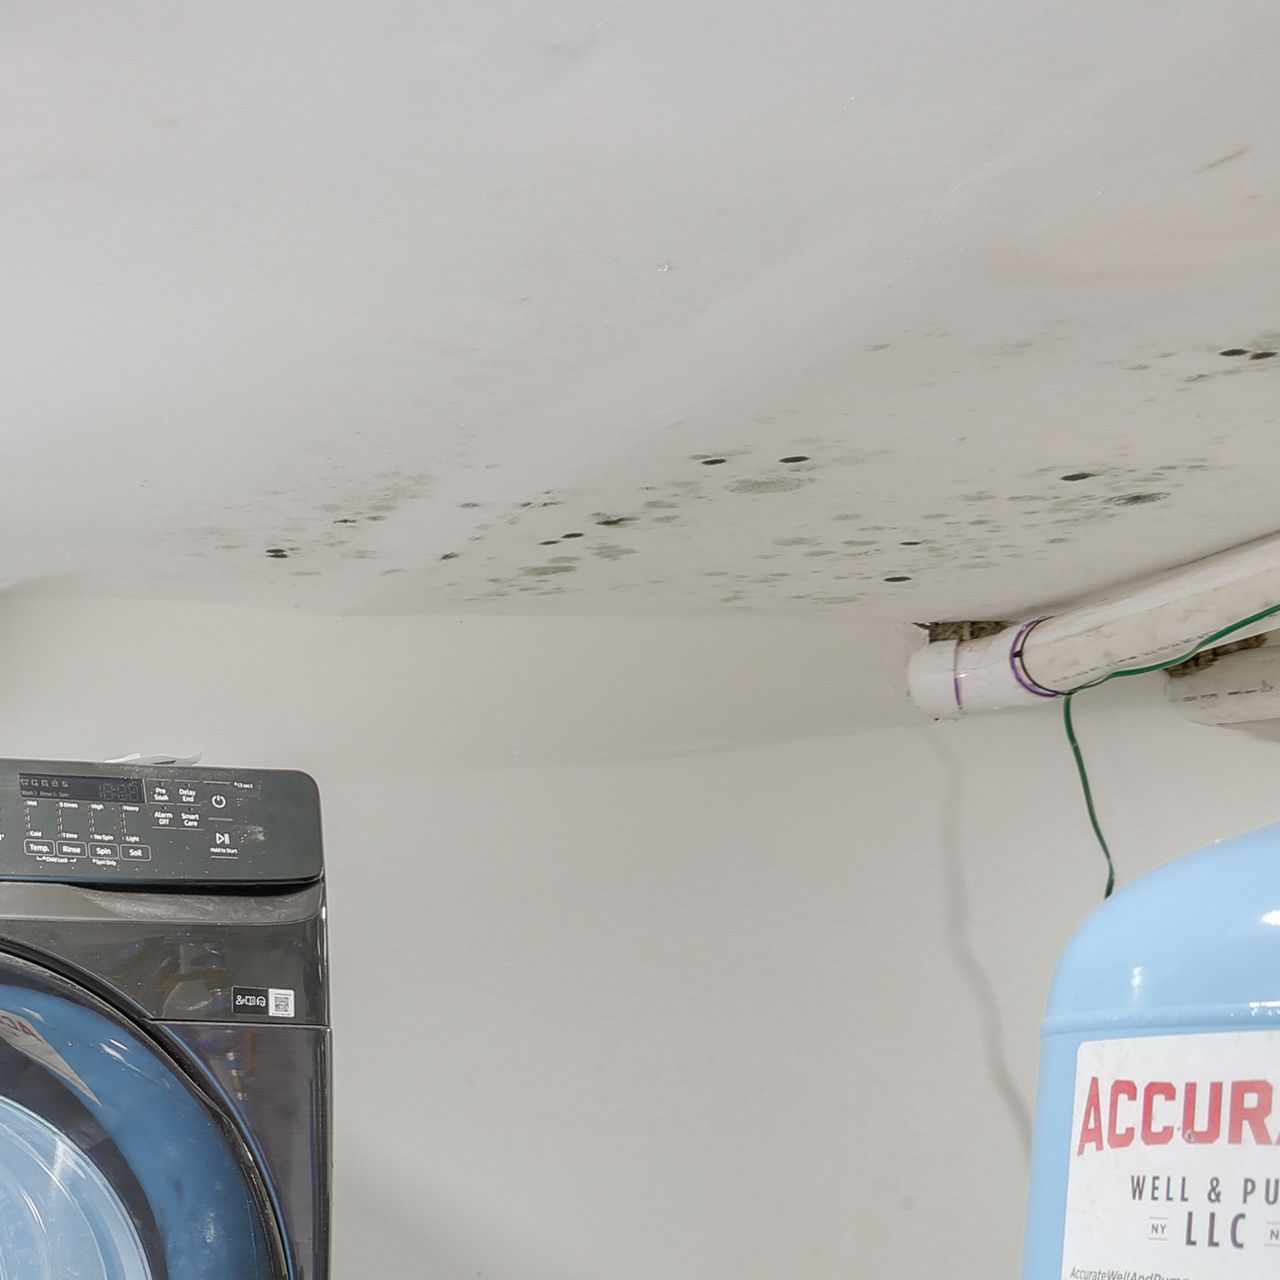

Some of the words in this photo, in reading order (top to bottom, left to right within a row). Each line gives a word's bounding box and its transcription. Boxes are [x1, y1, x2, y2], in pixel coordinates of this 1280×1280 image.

[179, 789, 196, 797] Delay
[30, 844, 50, 852] Temp.
[96, 848, 111, 856] Spin
[1076, 1076, 1280, 1157] ACCUR
[1130, 1174, 1189, 1202] WELL
[1206, 1176, 1222, 1204] &
[1151, 1223, 1166, 1235] NY
[1185, 1211, 1246, 1250] LLC
